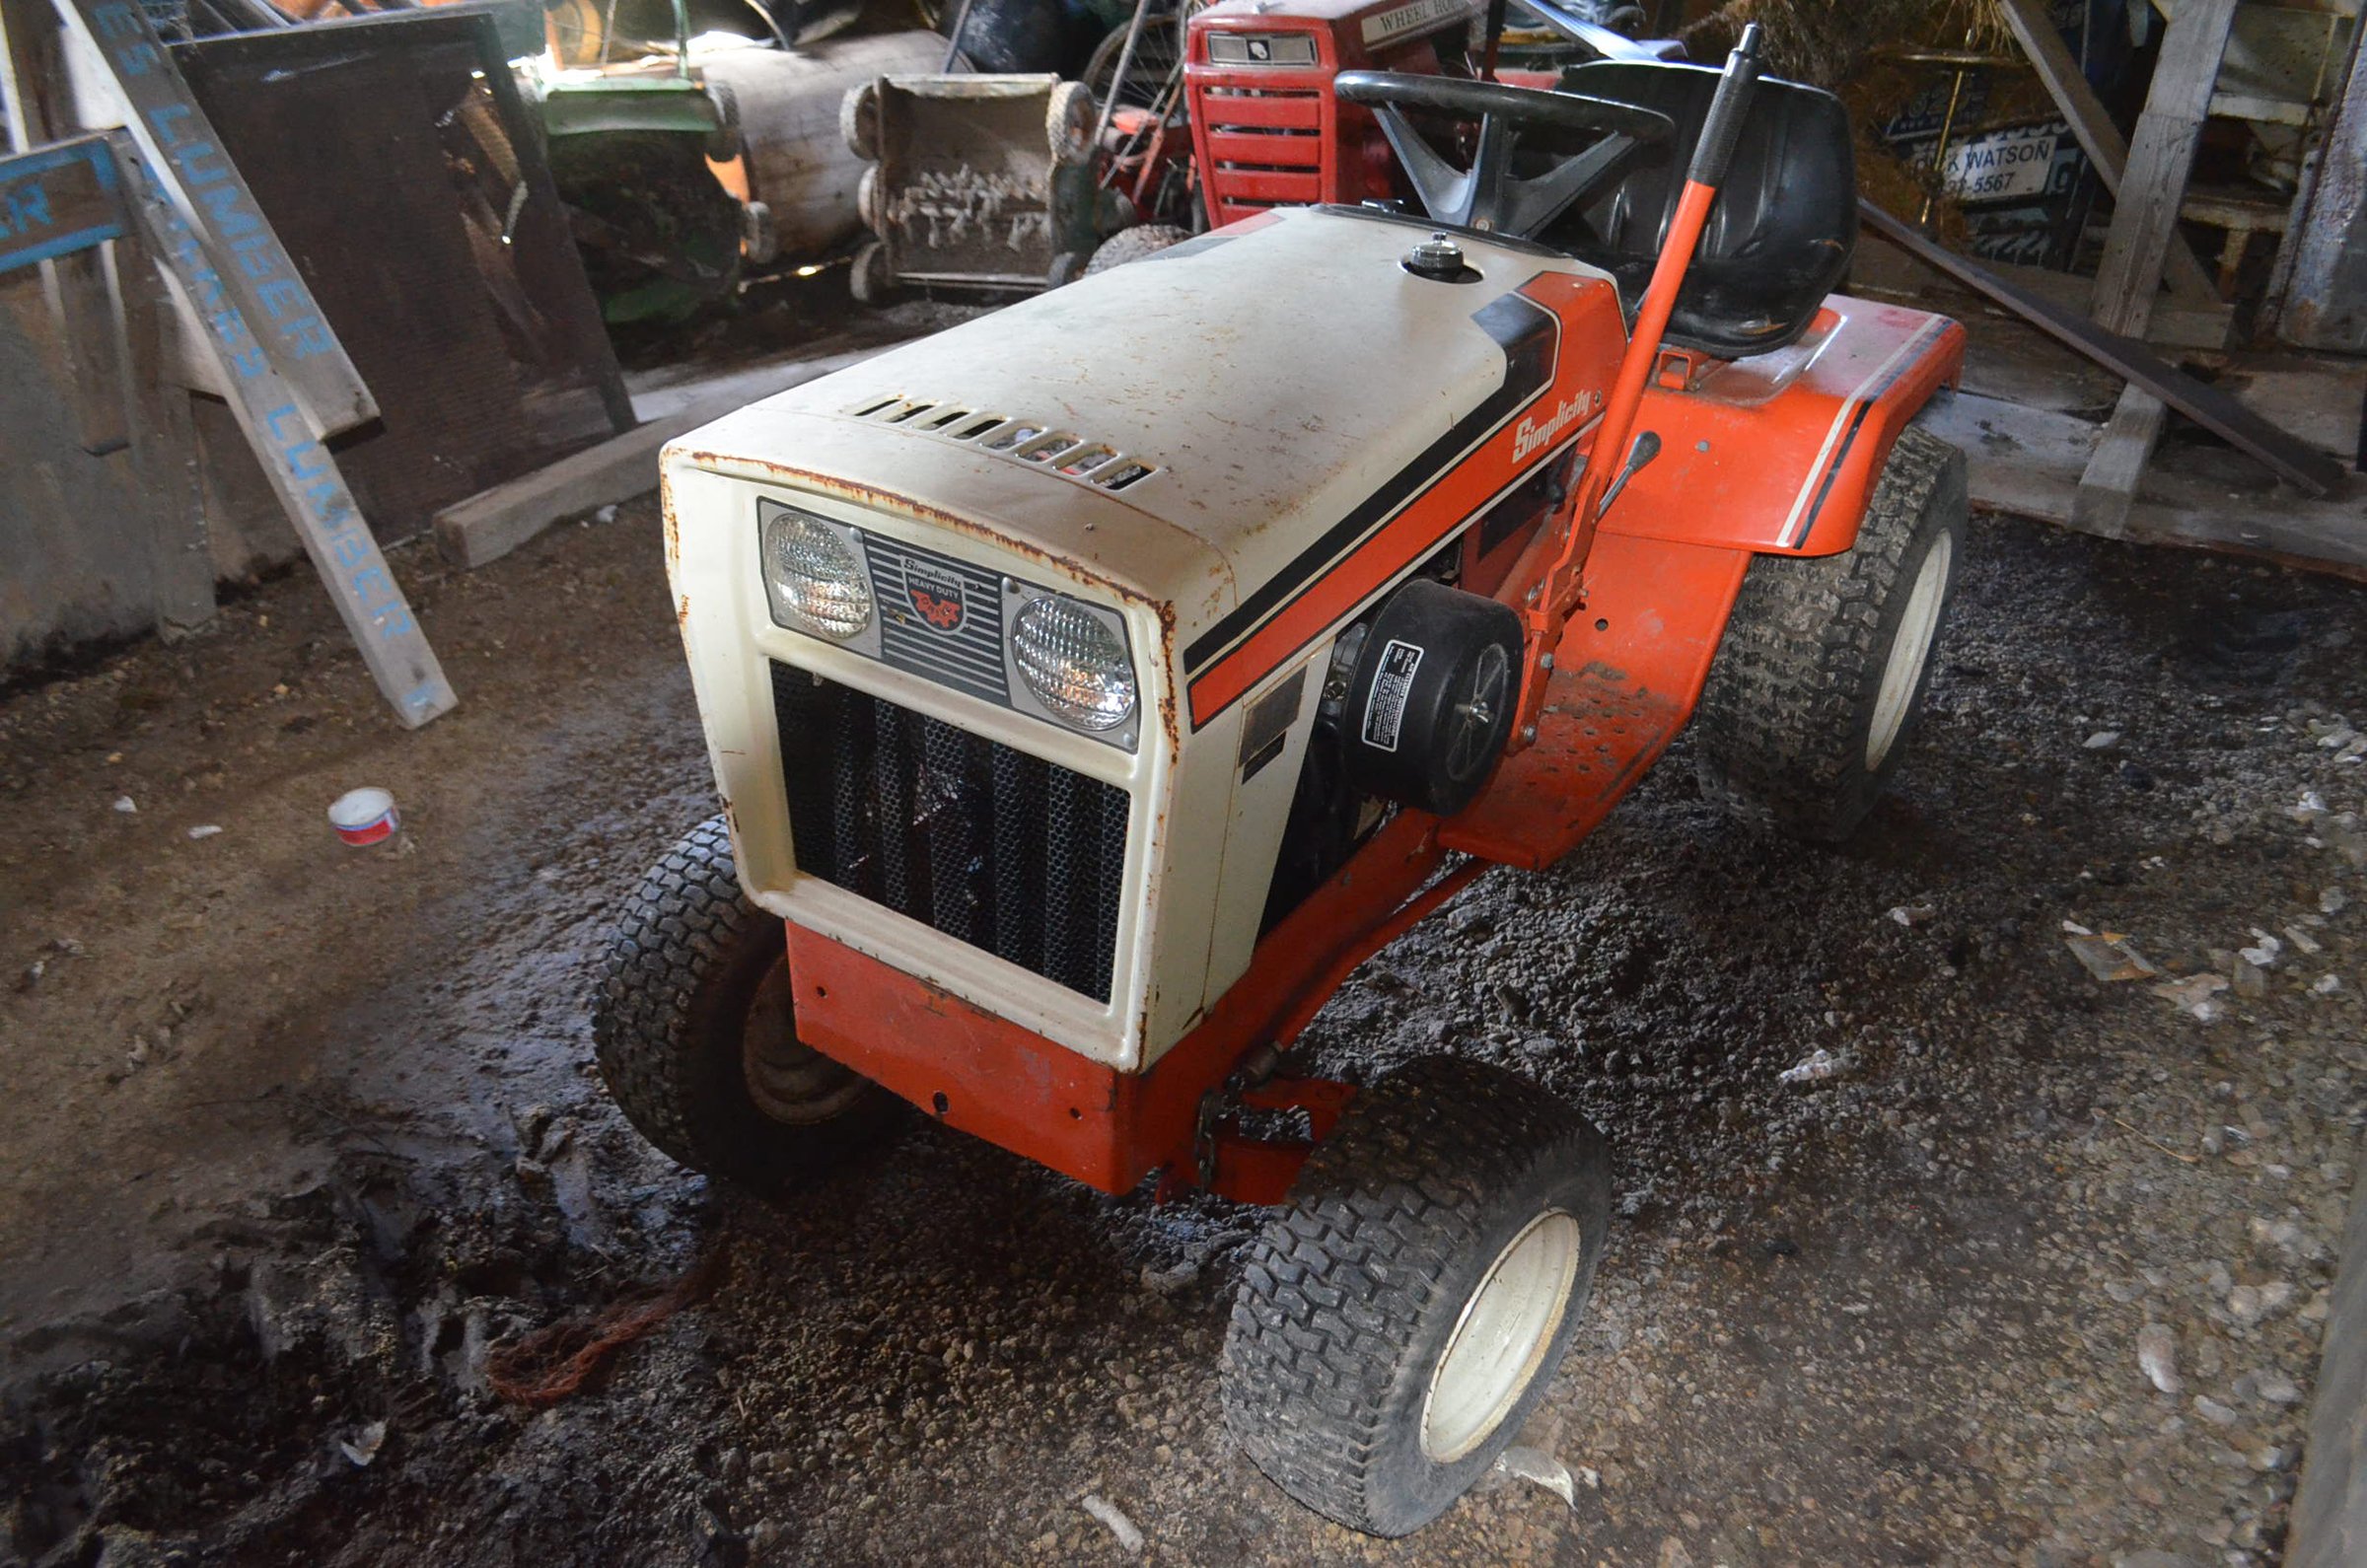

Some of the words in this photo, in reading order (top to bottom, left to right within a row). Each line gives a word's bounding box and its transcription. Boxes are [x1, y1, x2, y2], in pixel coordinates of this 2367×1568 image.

[1380, 3, 1428, 32] WHEEL
[1966, 144, 2049, 171] WATSON
[148, 104, 333, 361] LUMBER
[1512, 389, 1592, 463] Simplicity
[266, 402, 412, 641] LUMBER
[903, 558, 962, 587] Simplicity
[908, 576, 935, 592] HEAVY
[936, 585, 960, 599] DUTY
